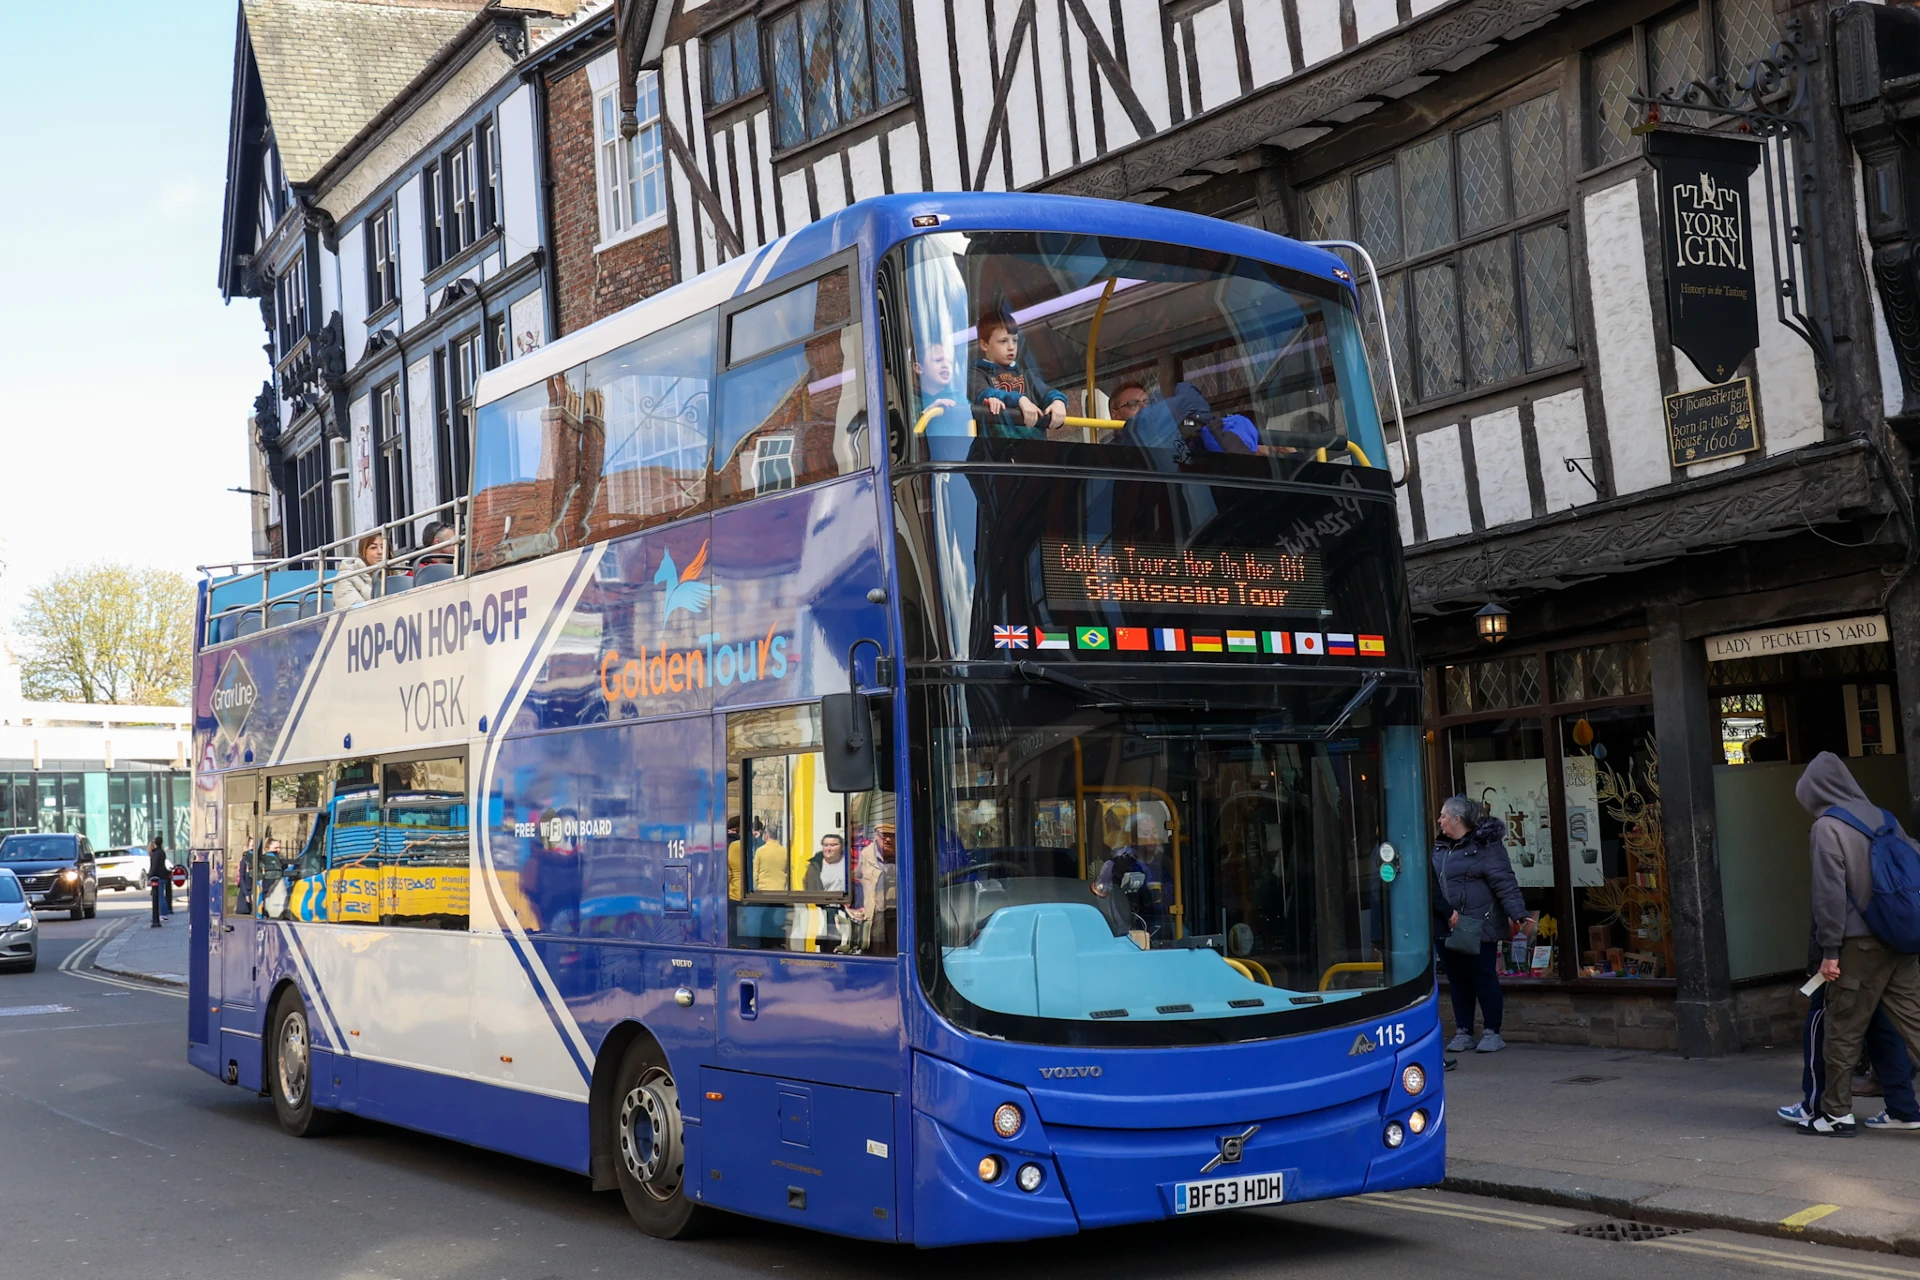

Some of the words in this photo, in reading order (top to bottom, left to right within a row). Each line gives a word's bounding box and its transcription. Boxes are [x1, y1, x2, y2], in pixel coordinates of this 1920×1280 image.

[1681, 211, 1738, 239] YORK
[1685, 235, 1736, 268] GIN
[1681, 283, 1706, 298] History
[1723, 285, 1747, 301] Tasting
[1670, 398, 1684, 419] Sir
[1684, 394, 1717, 415] Thomas
[1704, 426, 1738, 453] 1606
[1061, 544, 1119, 574] Golden
[1124, 547, 1178, 576] Tours
[1183, 550, 1214, 577] Hop
[1220, 552, 1241, 579] On
[1245, 553, 1275, 580] Hop
[1280, 555, 1305, 581] Off
[1085, 575, 1230, 604] Sightseeing
[1234, 581, 1289, 606] Tour
[348, 612, 422, 674] HOP-ON
[428, 585, 528, 657] HOP-OFF
[1716, 637, 1752, 655] LADY
[1837, 622, 1877, 641] YARD
[399, 675, 465, 733] YORK
[514, 822, 536, 838] FREE
[564, 821, 578, 836] ON
[580, 820, 612, 836] BOARD
[667, 839, 685, 859] 115
[671, 958, 693, 968] VOLVO
[1375, 1023, 1406, 1047] 115
[1039, 1066, 1103, 1079] VOLVO
[1189, 1181, 1239, 1208] BF63
[1244, 1177, 1280, 1202] HDH
